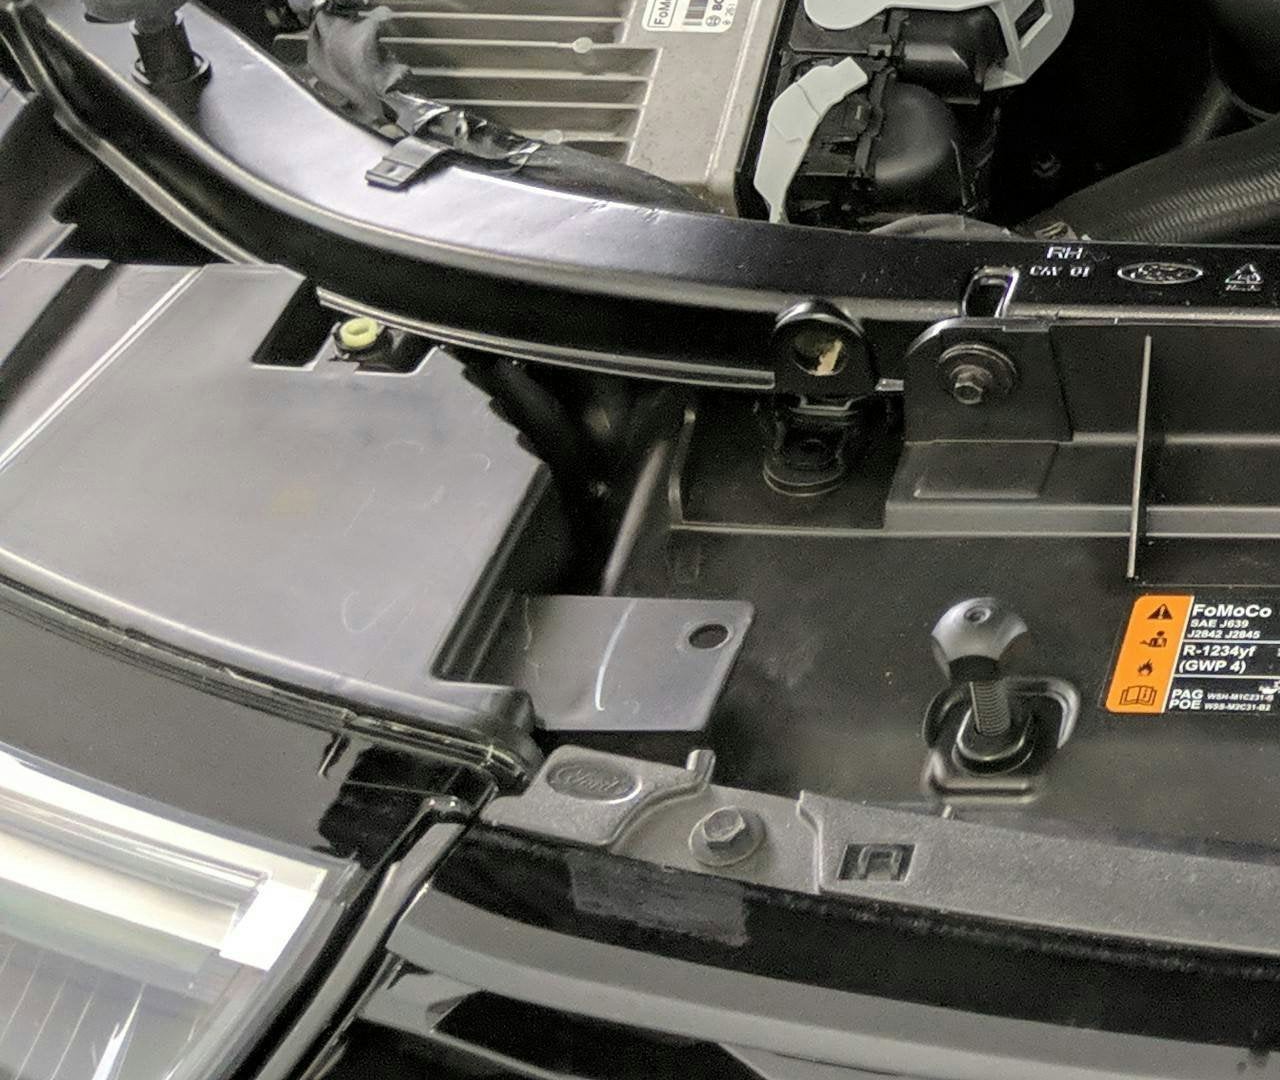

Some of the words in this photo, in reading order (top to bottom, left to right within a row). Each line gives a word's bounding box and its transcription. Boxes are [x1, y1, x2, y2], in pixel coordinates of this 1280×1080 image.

[1046, 246, 1084, 260] RH
[1192, 604, 1272, 618] FoMoCo
[1190, 619, 1218, 628] SAE
[1220, 619, 1250, 628] J639
[1186, 630, 1223, 639] J2842
[1224, 630, 1261, 640] J2845
[1182, 644, 1258, 660] R-1234yf
[1178, 660, 1228, 673] (GWP
[1230, 660, 1246, 674] 4)
[1171, 689, 1204, 700] PAG
[1168, 700, 1202, 710] POE
